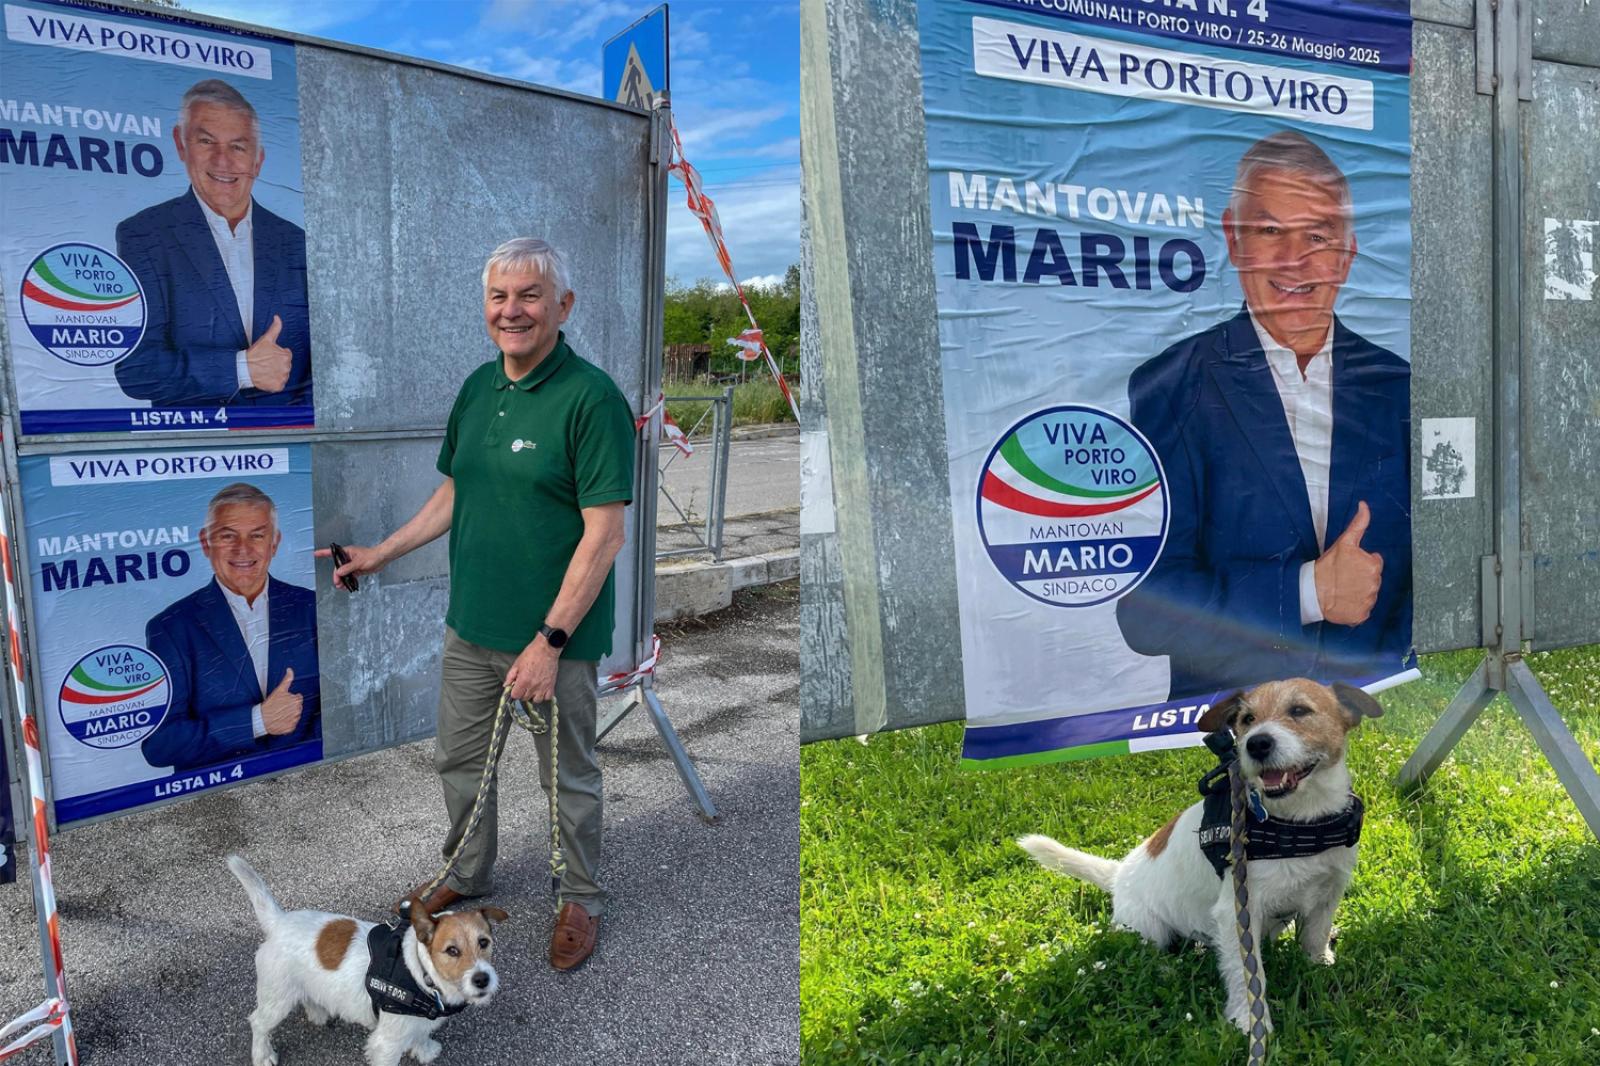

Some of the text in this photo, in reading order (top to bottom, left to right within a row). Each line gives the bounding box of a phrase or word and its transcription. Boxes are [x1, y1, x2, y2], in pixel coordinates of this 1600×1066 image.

[1246, 0, 1269, 23] 4
[1040, 0, 1132, 24] COMUNALI
[1137, 10, 1190, 33] PORTO
[1194, 20, 1232, 40] VIRO
[1236, 28, 1243, 44] /
[1247, 30, 1287, 49] 25-26
[1292, 37, 1345, 60] Maggio
[1349, 46, 1381, 64] 2025
[27, 15, 255, 70] VIVA PORTO VIRO
[1006, 33, 1348, 115] VIVA PORTO VIRO
[0, 99, 161, 138] MANTOVAN
[0, 127, 164, 178] MARIO
[948, 171, 1205, 229] MANTOVAN
[60, 252, 103, 268] VIVA
[952, 221, 1206, 293] MARIO
[75, 269, 116, 281] PORTO
[93, 283, 124, 294] VIRO
[55, 314, 117, 324] MANTOVAN
[51, 328, 125, 345] MARIO
[65, 349, 115, 359] SINDACO
[130, 406, 228, 426] LISTA N. 4
[1042, 422, 1108, 445] VIVA
[69, 453, 274, 480] VIVA PORTO VIRO
[1064, 448, 1126, 465] PORTO
[1090, 468, 1137, 485] VIRO
[1029, 521, 1124, 540] MANTOVAN
[38, 525, 190, 557] MANTOVAN
[1022, 543, 1134, 575] MARIO
[41, 549, 191, 592] MARIO
[1042, 577, 1118, 597] SINDACO
[95, 651, 134, 667] VIVA
[108, 662, 145, 676] PORTO
[124, 671, 151, 684] VIRO
[89, 700, 145, 718] MANTOVAN
[85, 711, 151, 736] MARIO
[97, 729, 142, 746] SINDACO
[154, 763, 244, 798] LISTA N. 4
